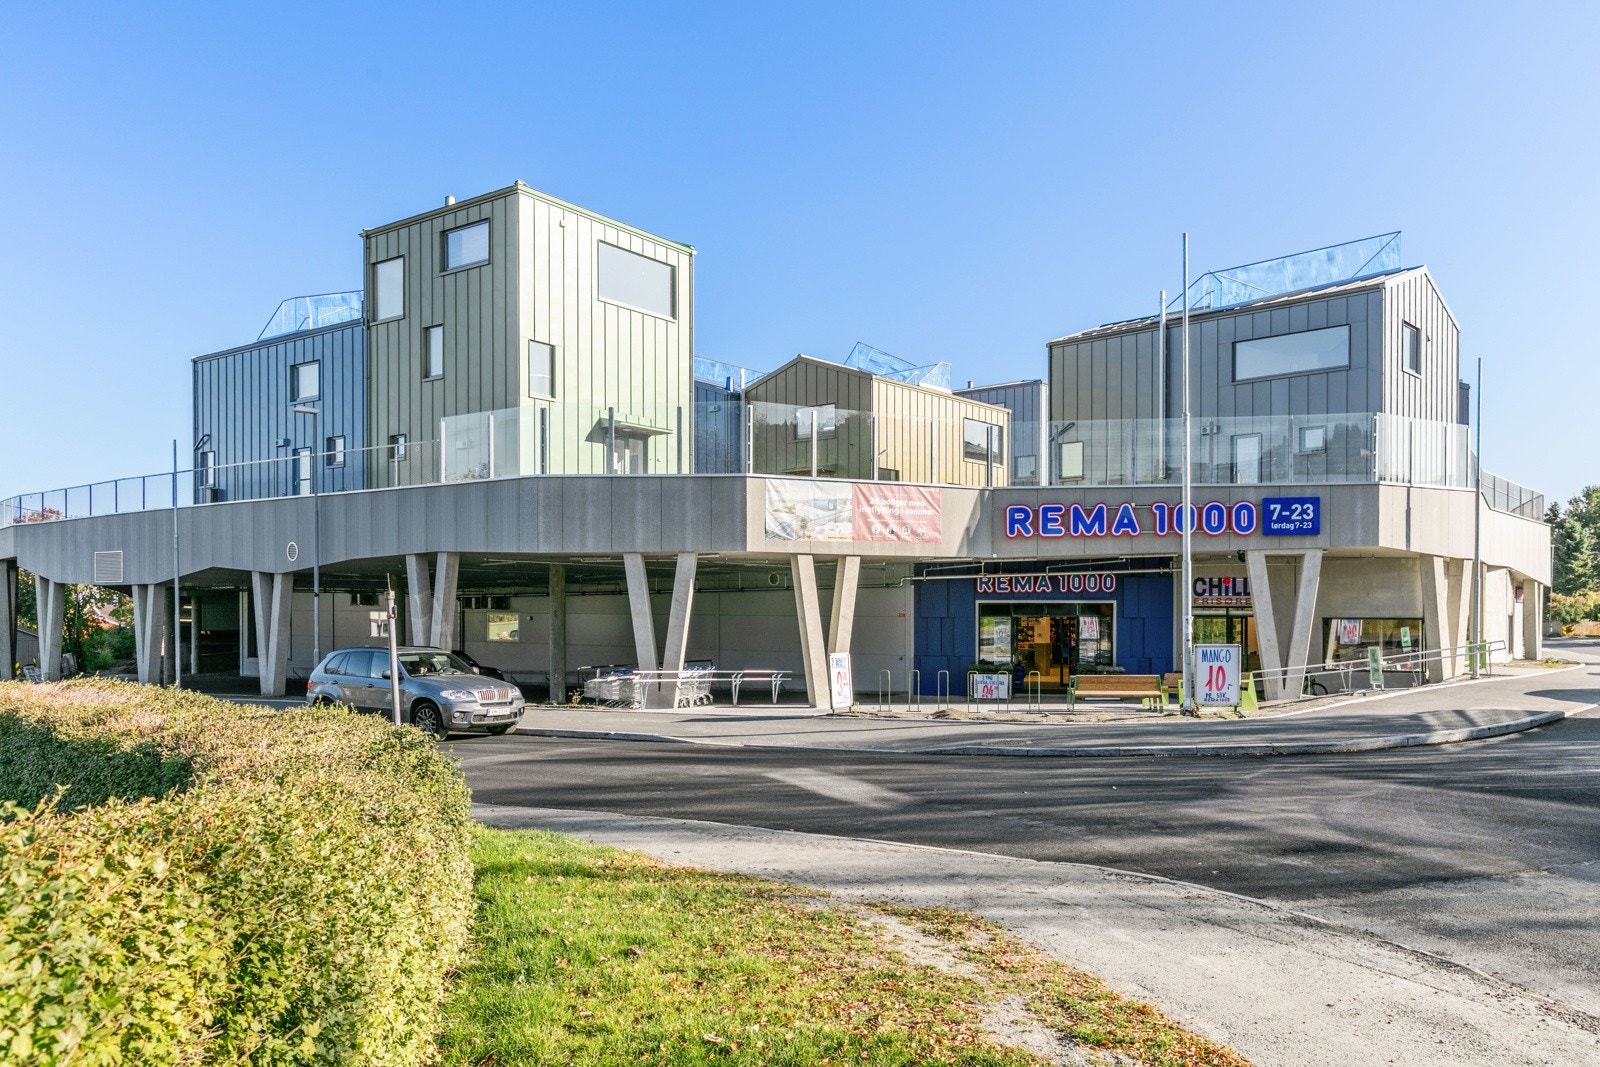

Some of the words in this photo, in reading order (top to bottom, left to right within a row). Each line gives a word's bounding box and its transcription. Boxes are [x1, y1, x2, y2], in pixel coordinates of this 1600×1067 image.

[1006, 503, 1140, 538] REMA
[1151, 501, 1258, 536] 1000
[1270, 503, 1314, 520] 7-23
[1271, 522, 1295, 530] lørdag
[976, 573, 1053, 593] REMA
[1058, 573, 1117, 593] 1000
[1202, 649, 1231, 662] MANGO
